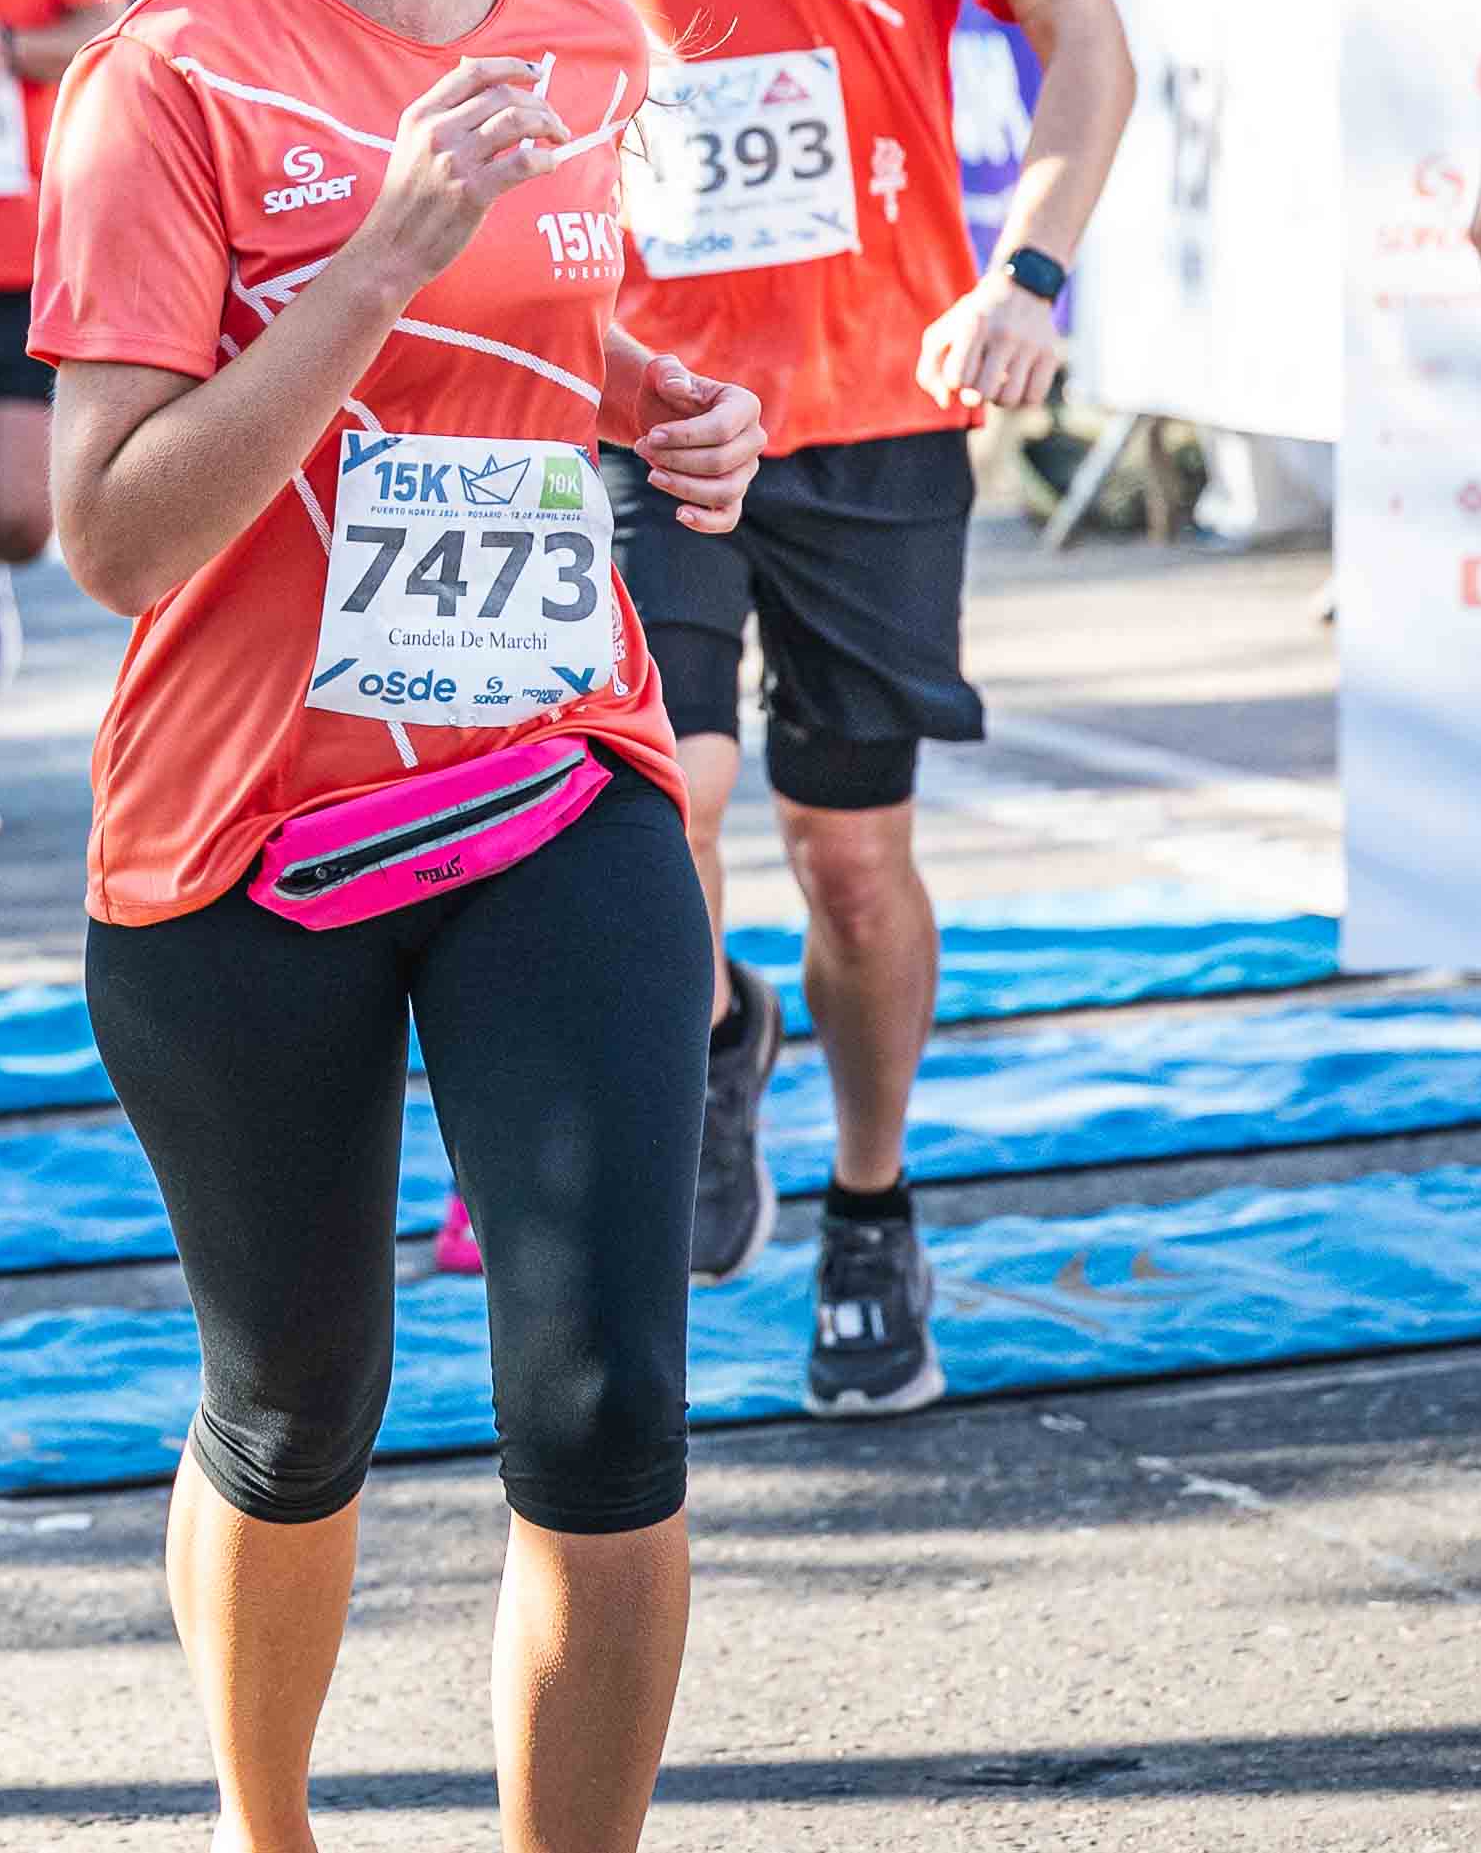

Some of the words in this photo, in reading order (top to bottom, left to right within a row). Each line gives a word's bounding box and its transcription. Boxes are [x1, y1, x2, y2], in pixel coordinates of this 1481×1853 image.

[651, 118, 834, 194] 393
[536, 211, 614, 263] 15K
[373, 460, 453, 504] 15K
[546, 472, 582, 495] 10K
[339, 524, 598, 623] 7473
[388, 627, 456, 649] Candela
[460, 630, 485, 649] De
[489, 631, 549, 651] Marchi
[358, 668, 457, 705] osde
